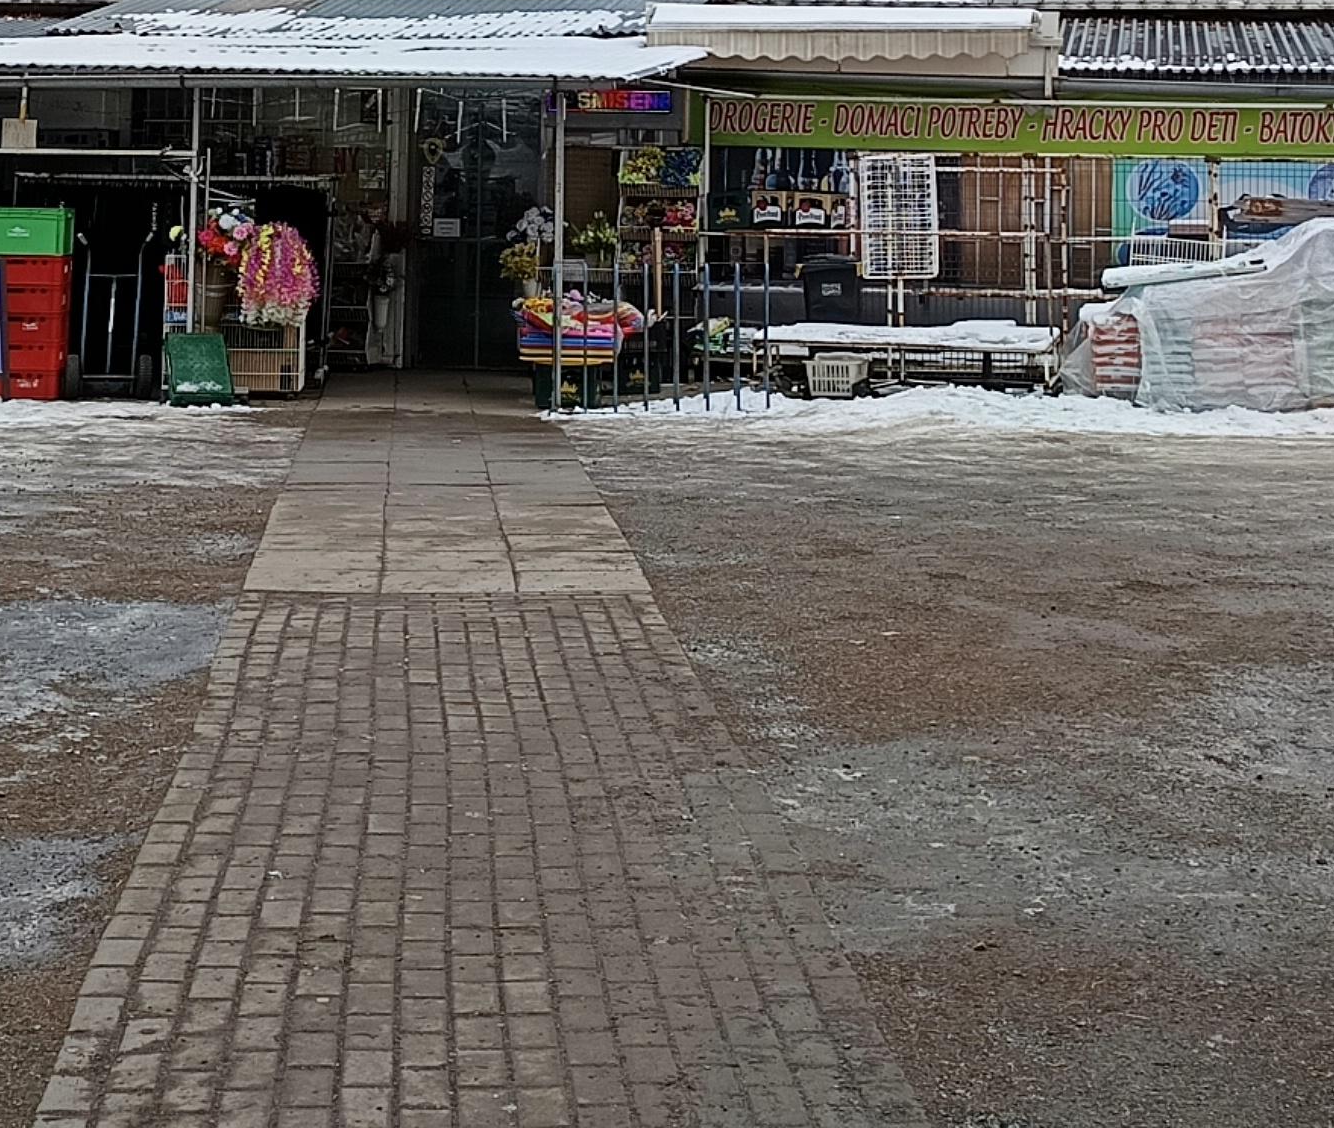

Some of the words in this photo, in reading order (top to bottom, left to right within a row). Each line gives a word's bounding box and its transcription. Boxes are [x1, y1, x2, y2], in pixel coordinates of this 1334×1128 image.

[709, 100, 816, 135] DROGERIE
[833, 103, 923, 138] DOMACI
[926, 104, 1025, 140] POTREBY
[1041, 106, 1133, 143] HRACKY
[1136, 109, 1184, 143] PRO
[1189, 109, 1239, 143] DETI
